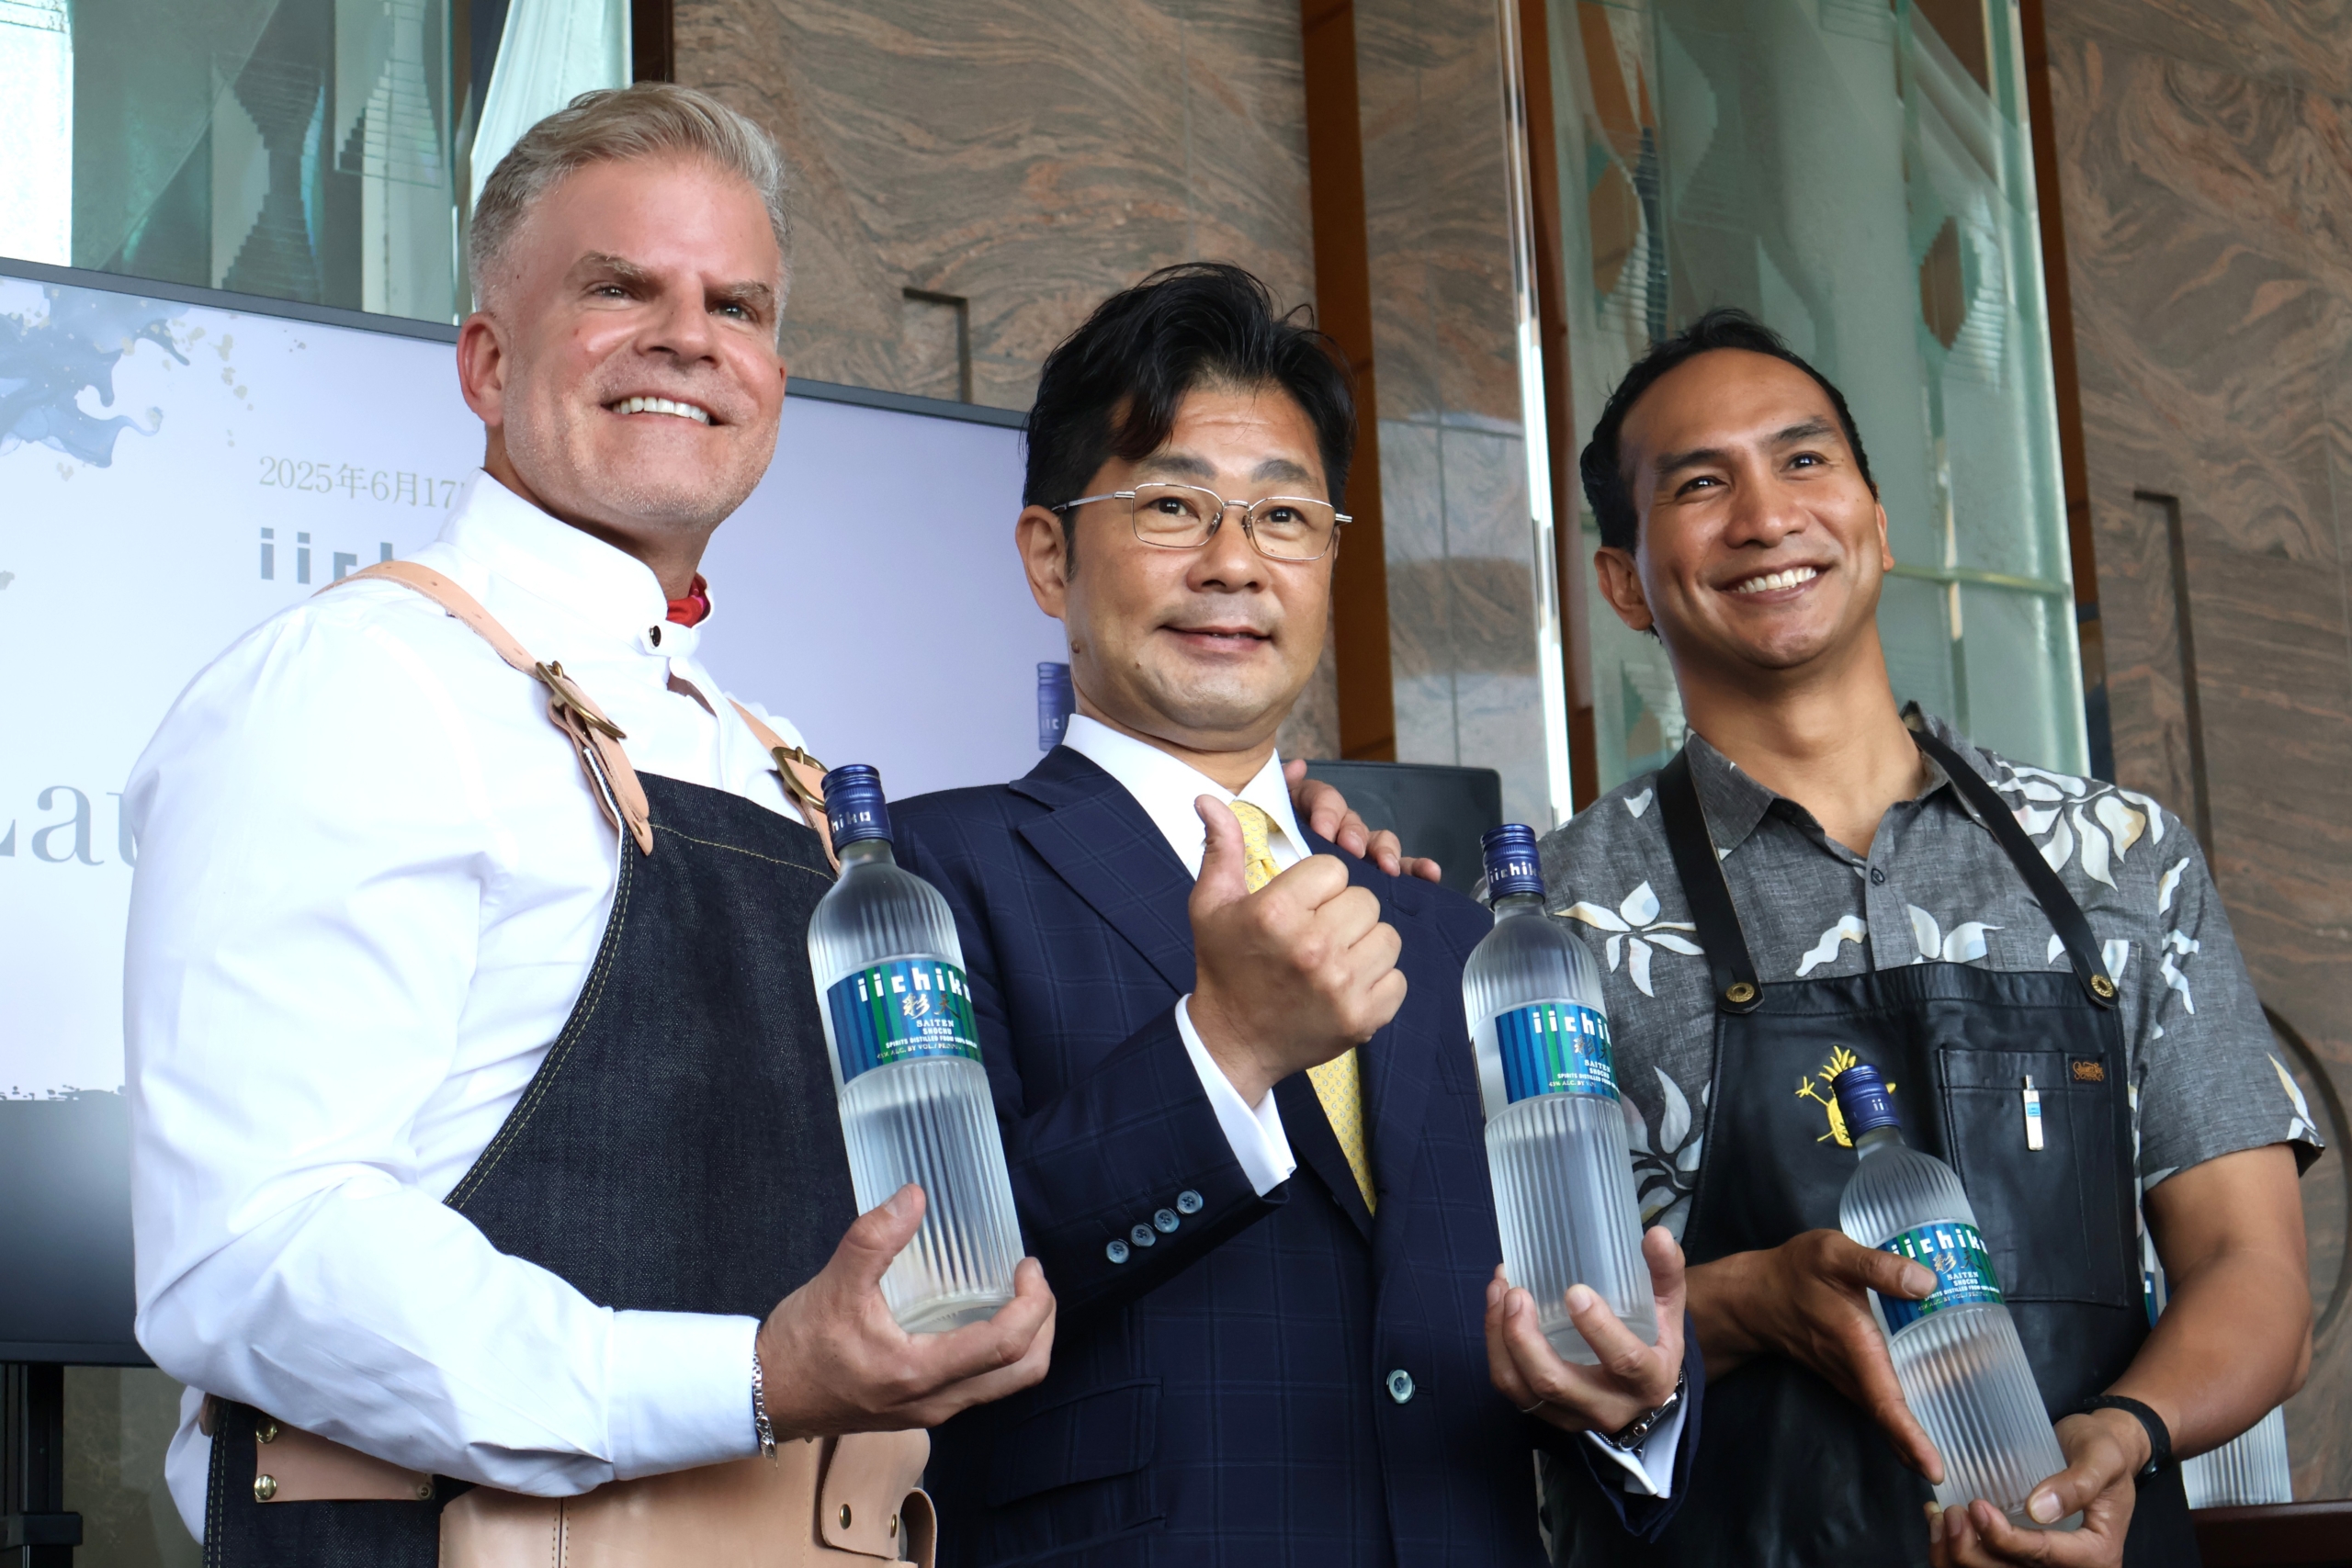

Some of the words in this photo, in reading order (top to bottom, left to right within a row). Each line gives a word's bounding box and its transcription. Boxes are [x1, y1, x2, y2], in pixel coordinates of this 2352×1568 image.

[259, 456, 464, 509] 2025年6月17
[916, 1020, 955, 1028] SAITEN
[885, 1038, 909, 1049] SPIRITS
[910, 1035, 939, 1044] DISTILLED
[1584, 1059, 1611, 1073] SAITEN
[1589, 1067, 1611, 1079] SHOCHU
[1578, 1074, 1601, 1082] DISTILLED
[1947, 1271, 1979, 1280] SAITEN
[1953, 1279, 1978, 1287] SHOCHU
[1943, 1286, 1968, 1295] DISTILLED
